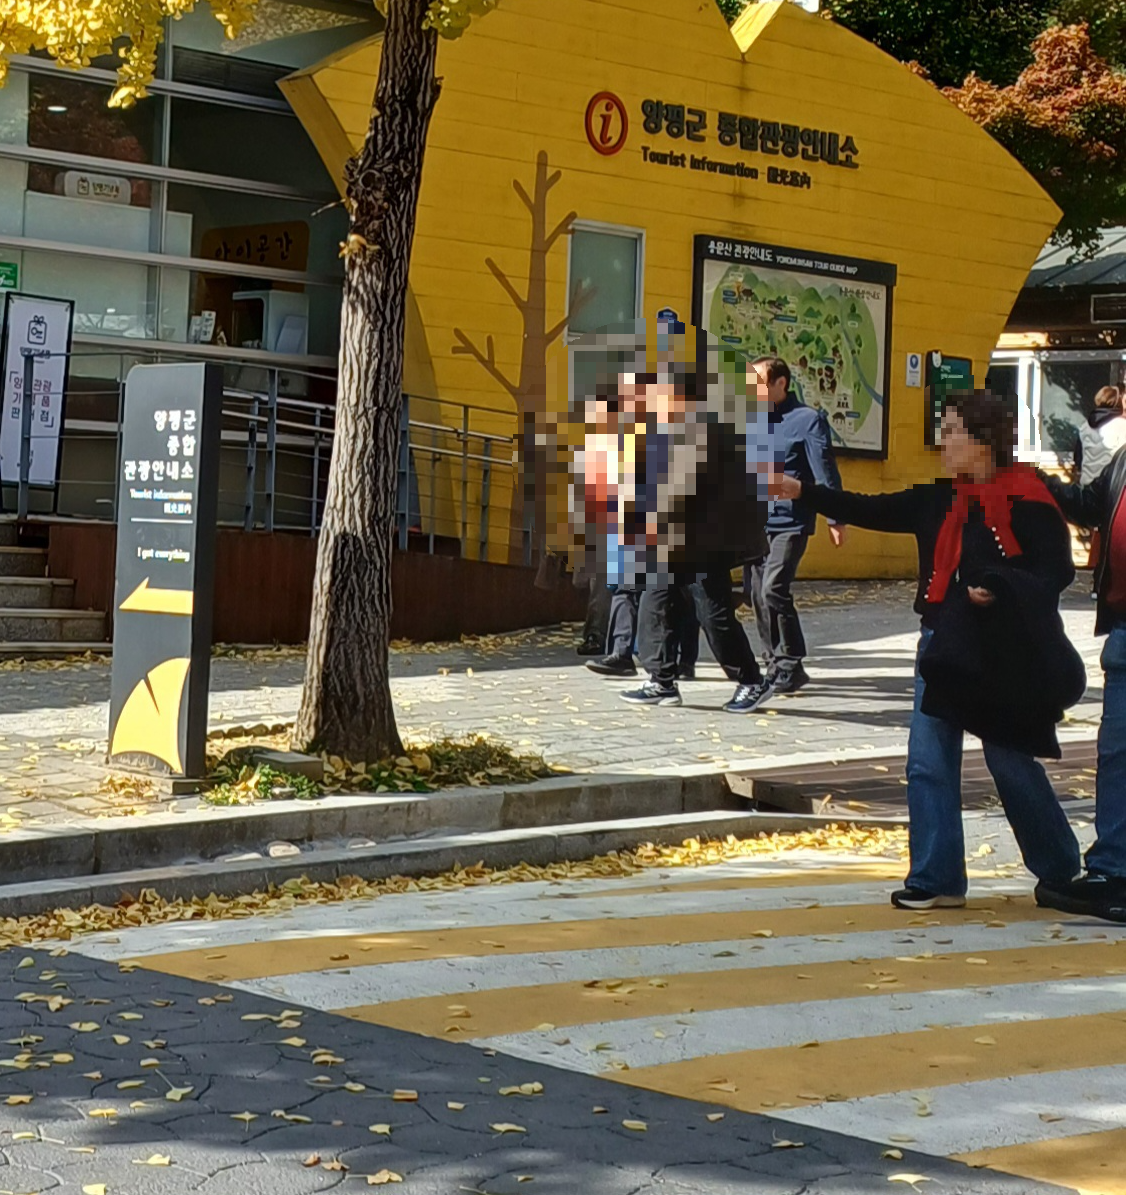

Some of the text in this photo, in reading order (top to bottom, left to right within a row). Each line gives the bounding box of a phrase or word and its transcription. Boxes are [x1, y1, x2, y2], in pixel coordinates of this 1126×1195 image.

[641, 99, 859, 169] 양평군 종합관광안내소
[641, 146, 686, 168] Tourist
[708, 240, 773, 262] 용문산 관광안내도
[12, 376, 53, 393] 양관광
[12, 391, 51, 407] 기품
[154, 409, 196, 431] 양평군
[167, 434, 196, 456] 종합
[124, 460, 194, 481] 관광안내소
[129, 488, 152, 500] Tourist
